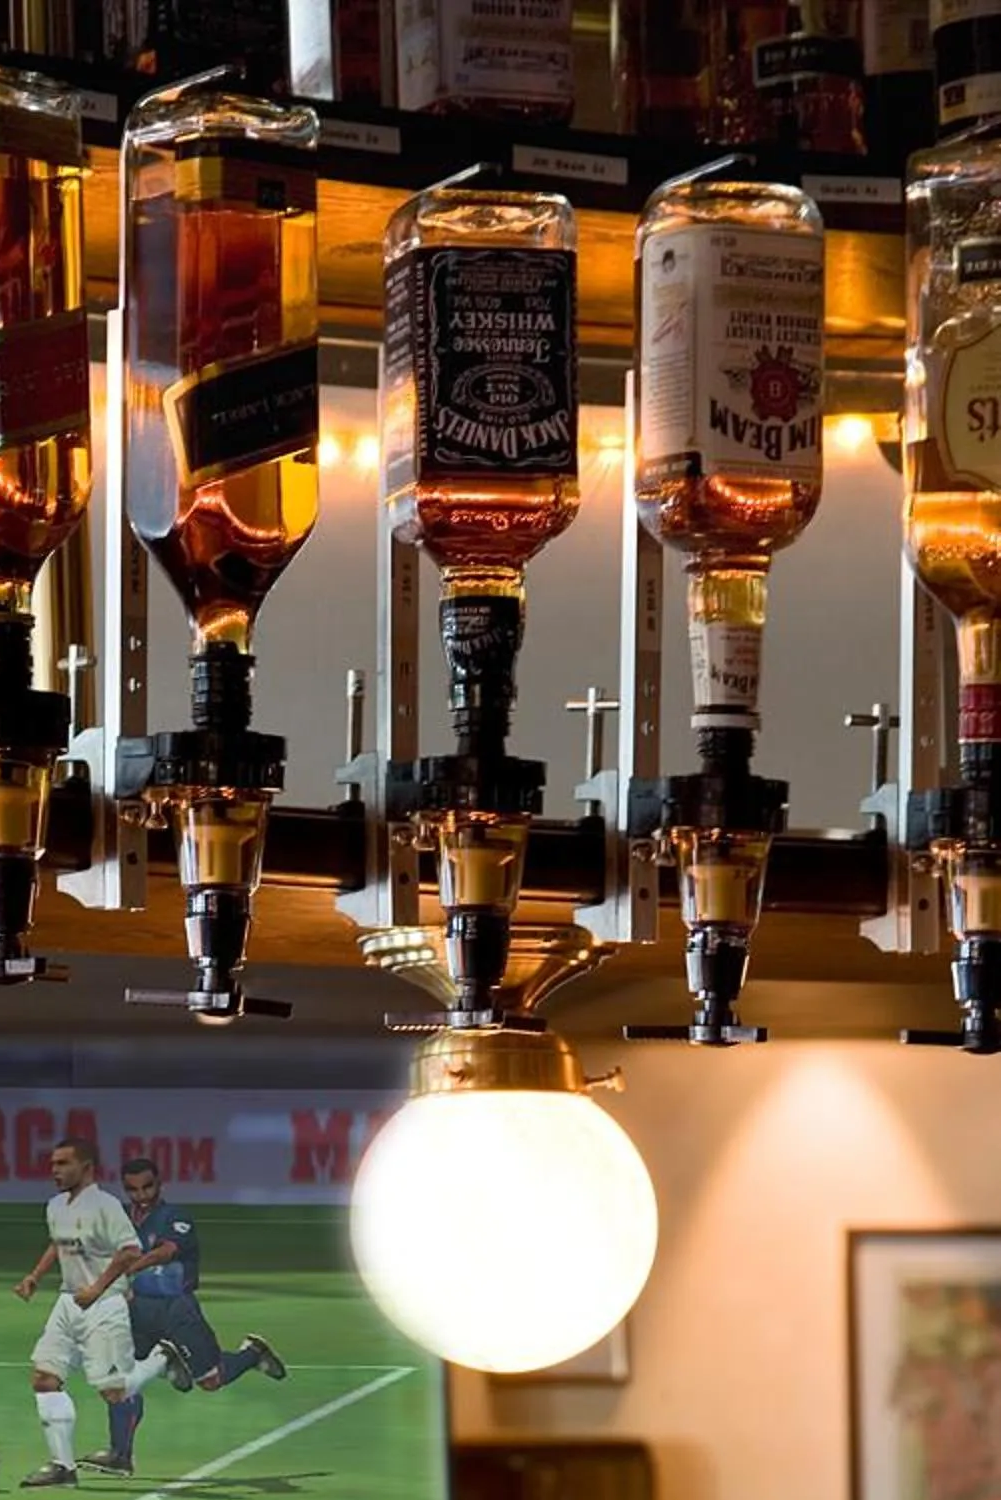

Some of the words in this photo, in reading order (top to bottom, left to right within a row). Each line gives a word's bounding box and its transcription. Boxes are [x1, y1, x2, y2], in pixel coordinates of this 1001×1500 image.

[449, 311, 556, 331] WHISKEY
[452, 337, 551, 364] Tennessee
[432, 406, 518, 459] DANIEL'S
[519, 409, 570, 451] JACK
[710, 400, 783, 461] BEAM
[787, 416, 817, 453] IM
[967, 397, 1001, 445] t's
